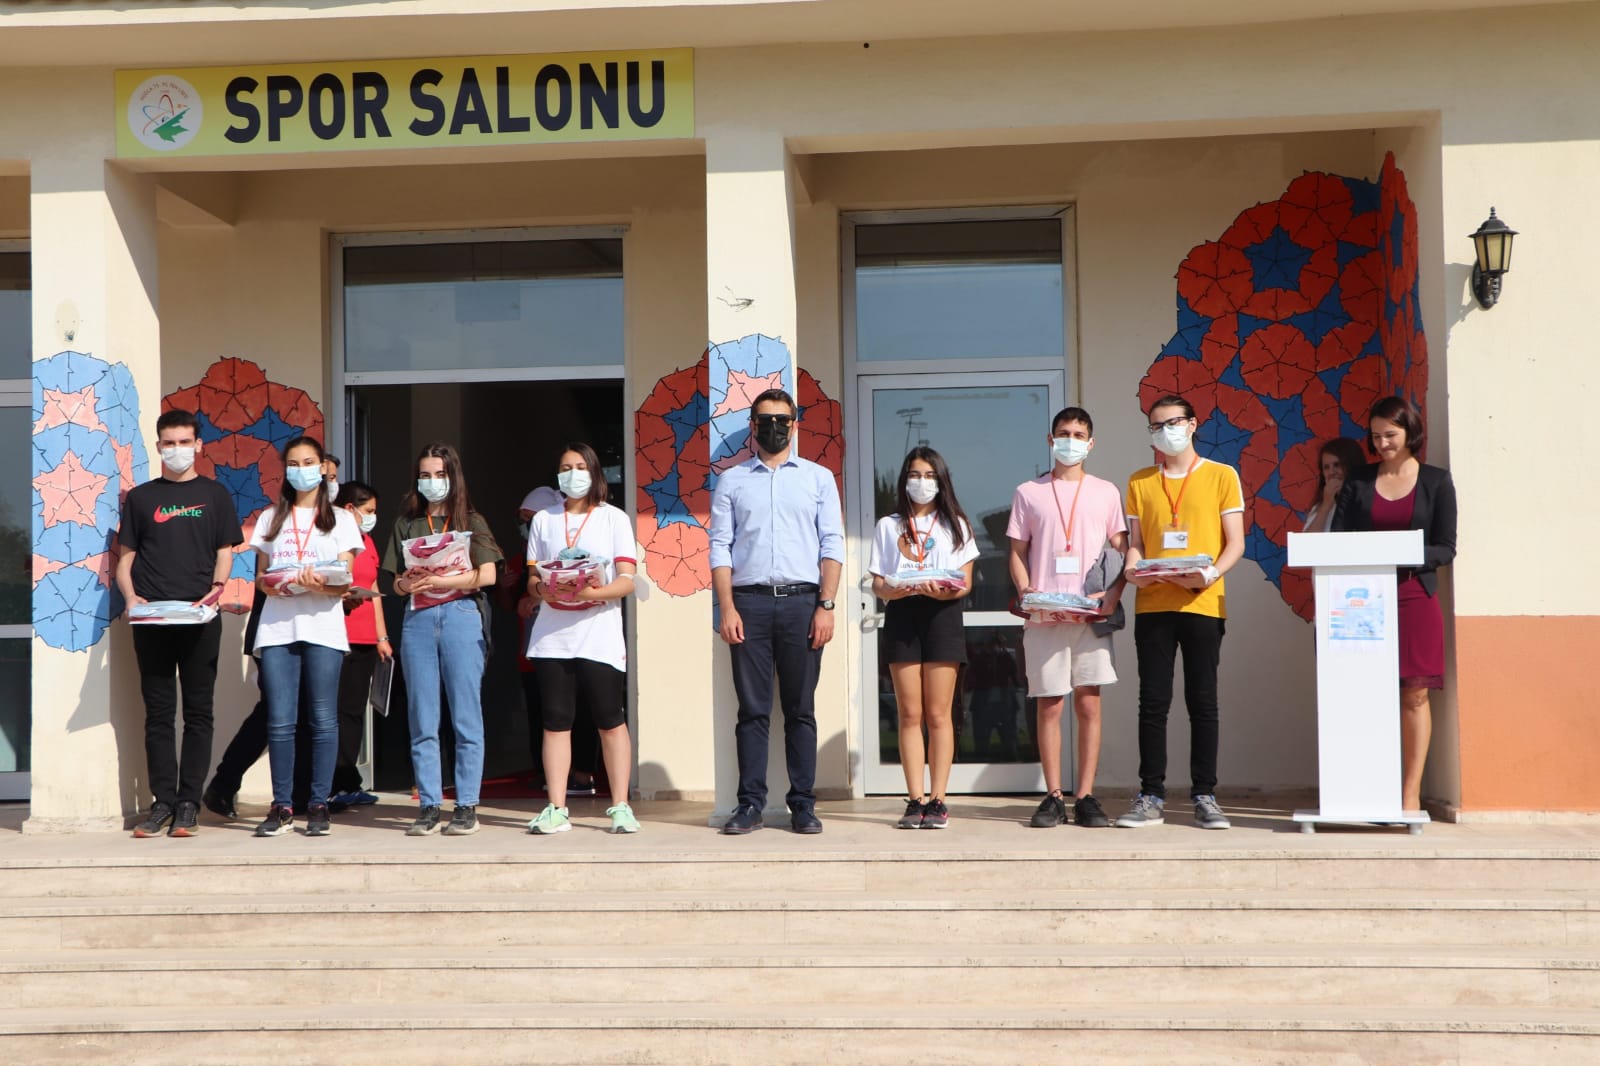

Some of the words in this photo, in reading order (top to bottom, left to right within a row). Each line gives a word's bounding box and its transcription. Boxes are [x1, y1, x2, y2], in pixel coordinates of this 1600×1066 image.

[224, 72, 392, 143] SPOR
[408, 60, 665, 136] SALONU
[160, 504, 203, 517] Athlete
